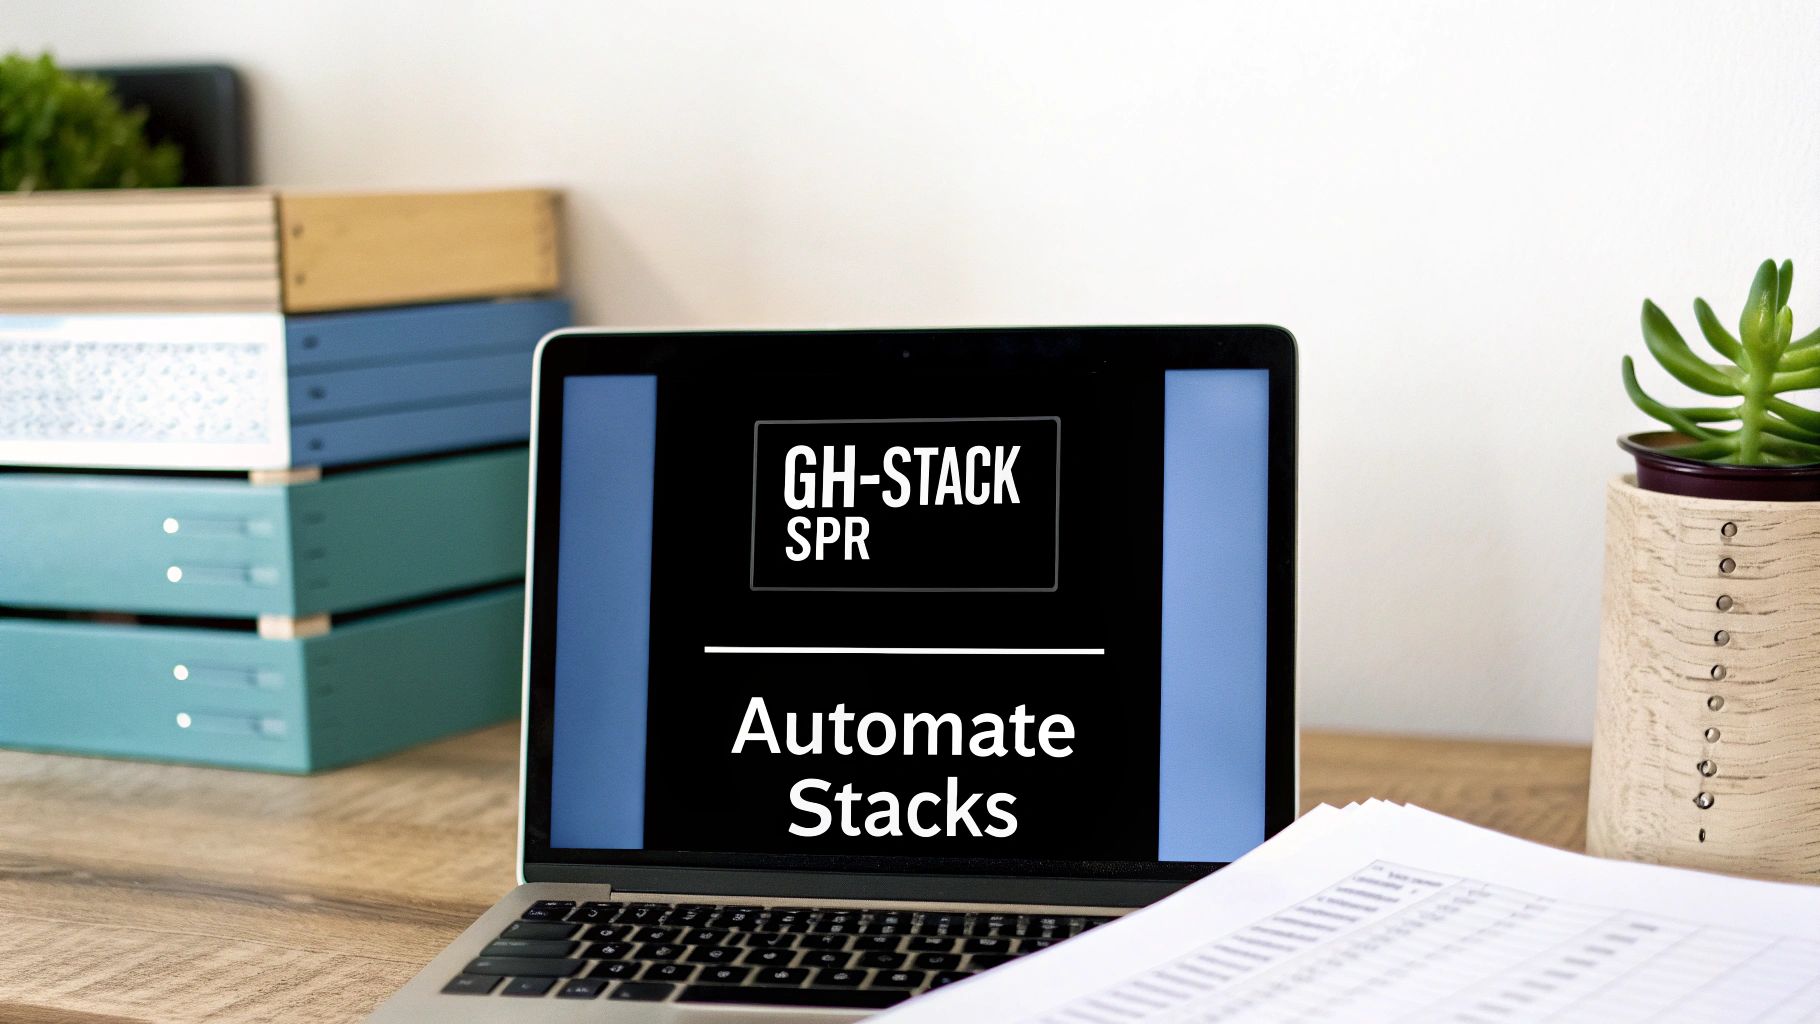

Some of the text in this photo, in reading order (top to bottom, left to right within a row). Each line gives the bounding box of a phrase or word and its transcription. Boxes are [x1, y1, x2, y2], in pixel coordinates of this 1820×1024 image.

[784, 445, 1021, 510] GH-STACK
[785, 516, 870, 562] SPR
[731, 696, 1076, 758] Automate
[788, 776, 1018, 838] Stacks
